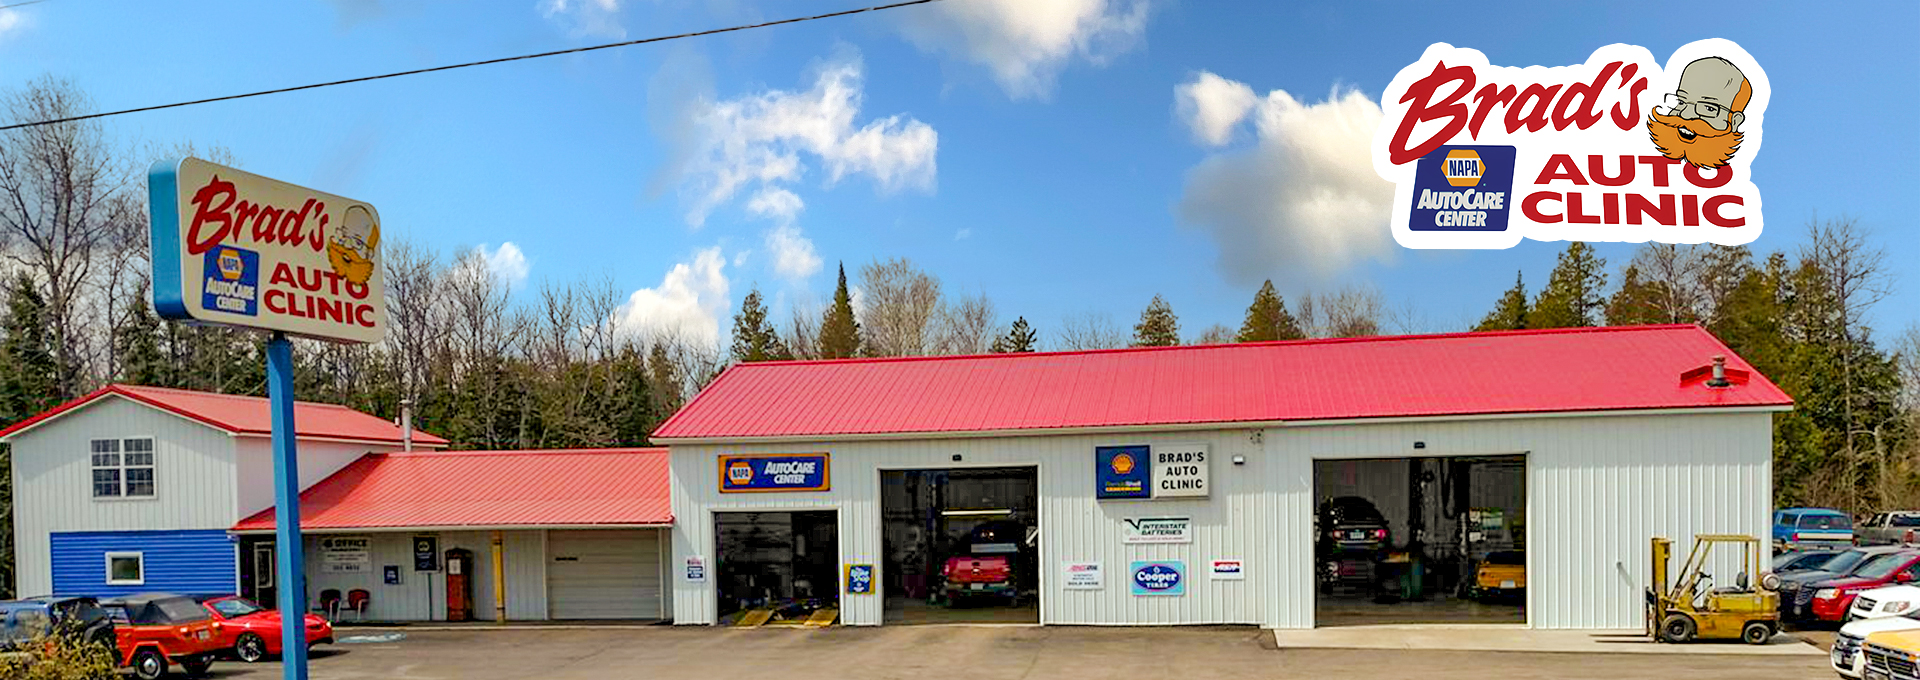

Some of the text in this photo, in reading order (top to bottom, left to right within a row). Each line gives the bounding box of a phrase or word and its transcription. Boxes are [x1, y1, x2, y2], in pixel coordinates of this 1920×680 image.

[187, 174, 329, 256] Brad's
[269, 262, 370, 300] AUTO
[216, 298, 248, 312] CENTER
[263, 289, 376, 328] CLINIC
[1158, 452, 1205, 463] BRAD'S
[1165, 465, 1198, 477] AUTO
[773, 474, 806, 485] CENTER
[1161, 479, 1204, 490] CLINIC
[1136, 571, 1178, 583] Cooper
